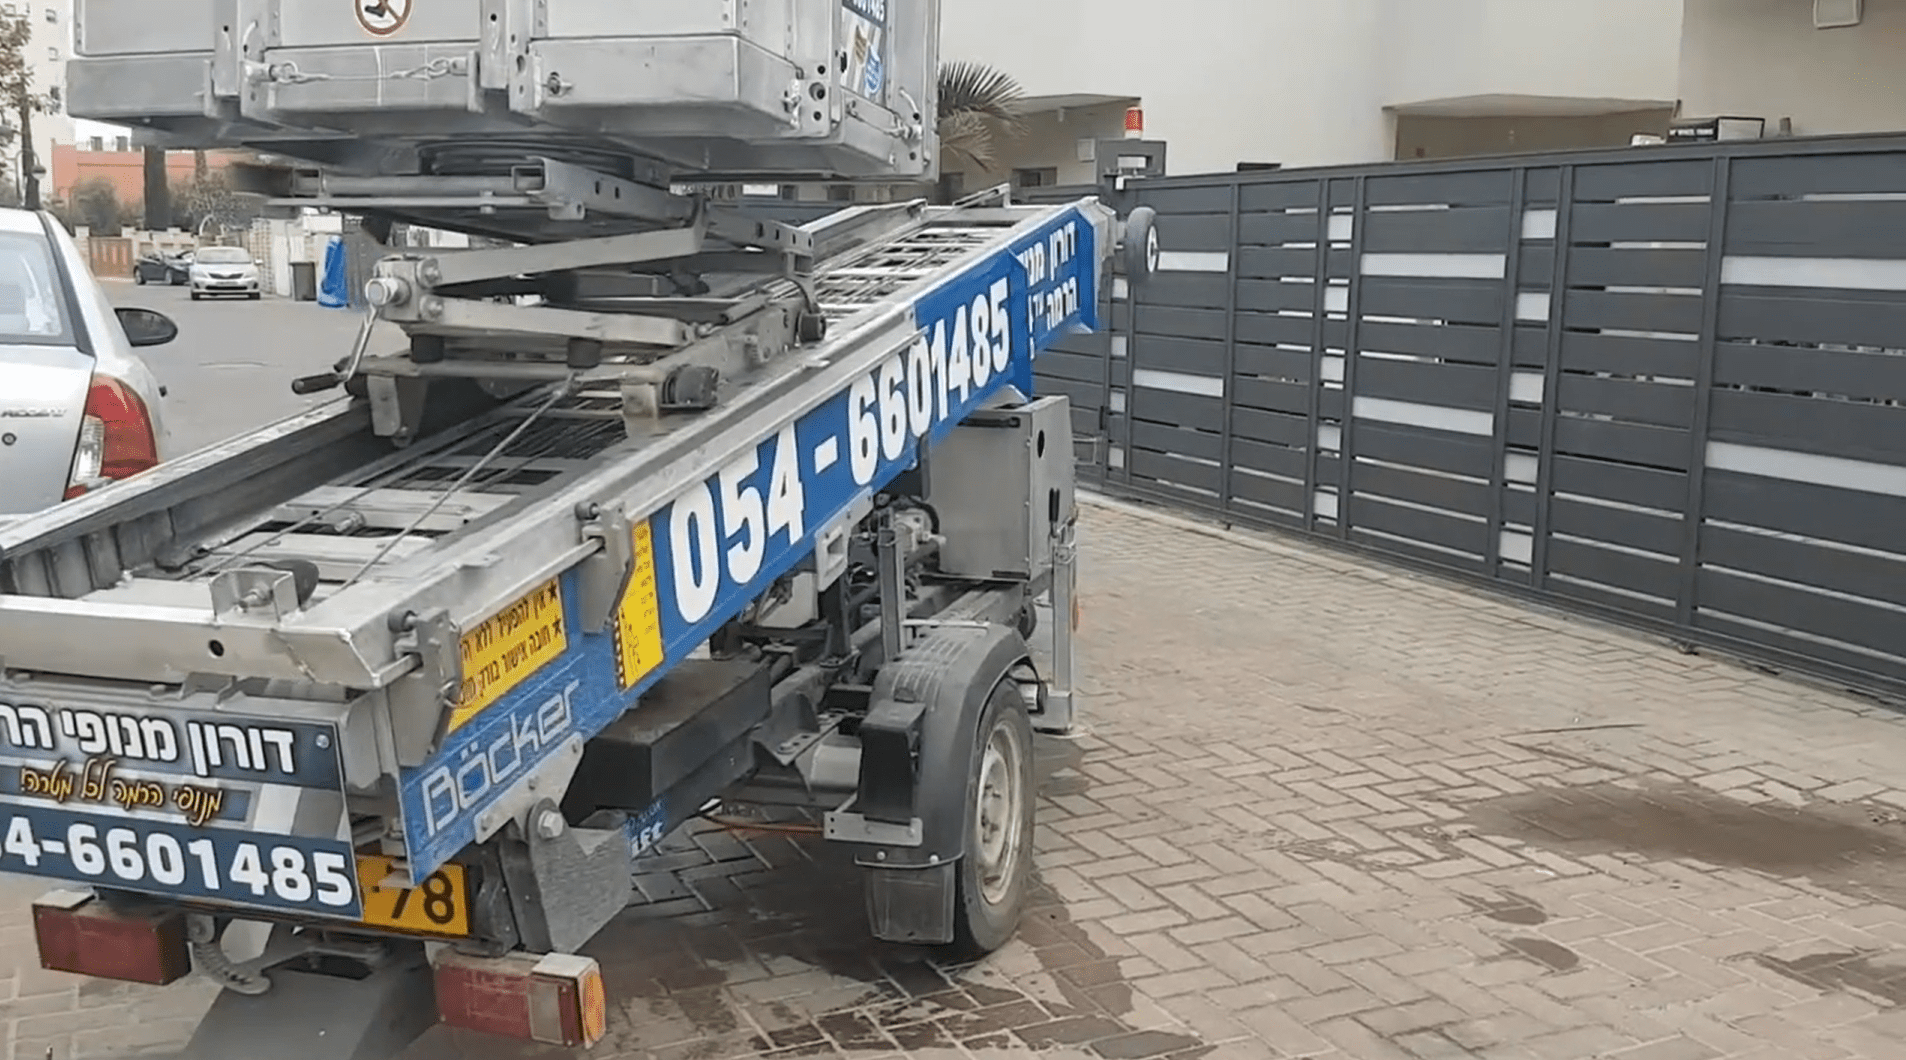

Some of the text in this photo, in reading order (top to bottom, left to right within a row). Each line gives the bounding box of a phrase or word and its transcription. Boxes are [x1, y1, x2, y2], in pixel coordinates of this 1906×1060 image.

[670, 277, 1011, 624] 054-6601485
[60, 709, 179, 762] מנופי
[188, 721, 294, 777] דורון
[422, 679, 580, 838] Böcker
[80, 758, 117, 801] לכל
[112, 778, 165, 811] הרמה
[172, 784, 224, 827] מנופי
[0, 816, 353, 906] 4-6601485
